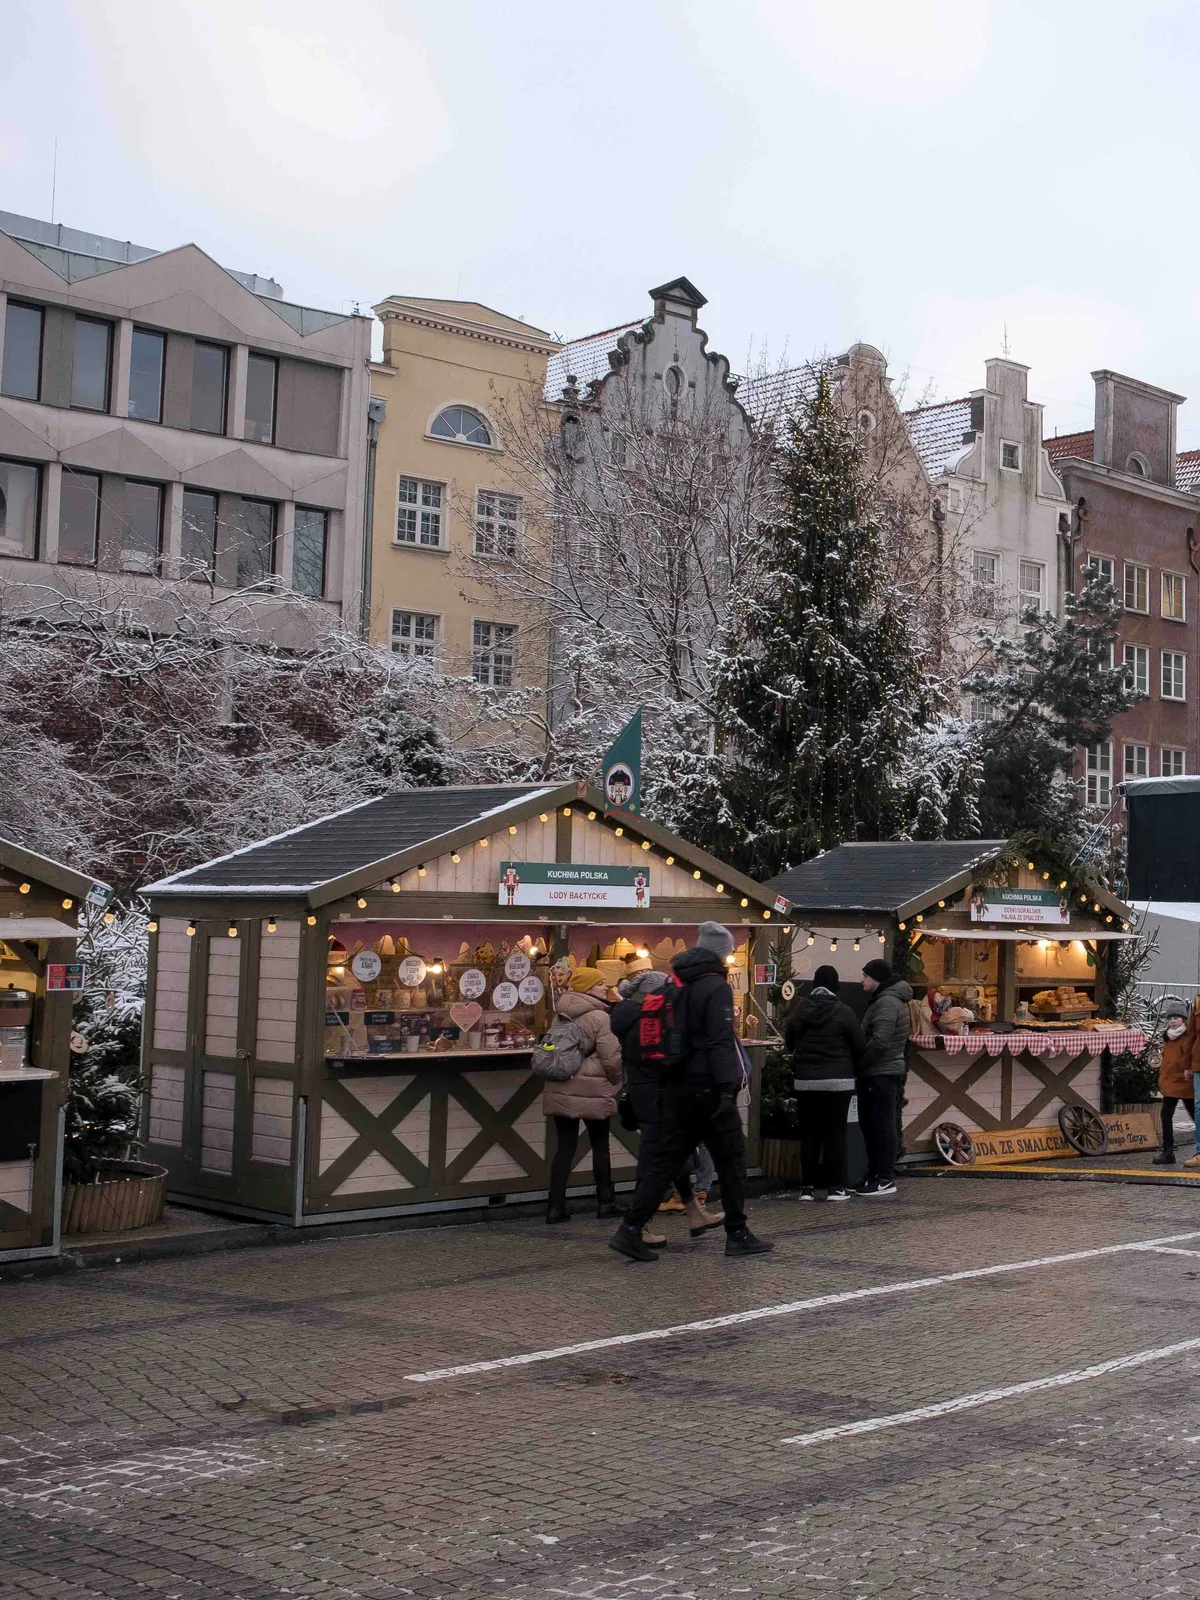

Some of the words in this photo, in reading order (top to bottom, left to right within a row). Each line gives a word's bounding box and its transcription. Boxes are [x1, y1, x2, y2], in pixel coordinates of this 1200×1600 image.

[548, 871, 579, 879] KUCHNIA
[95, 887, 106, 896] 34
[728, 973, 741, 989] RY
[1106, 1120, 1124, 1133] Serki
[975, 1142, 998, 1156] JDA
[1000, 1140, 1015, 1154] ZE
[1019, 1137, 1069, 1153] SMALCEM
[1108, 1137, 1126, 1147] wego
